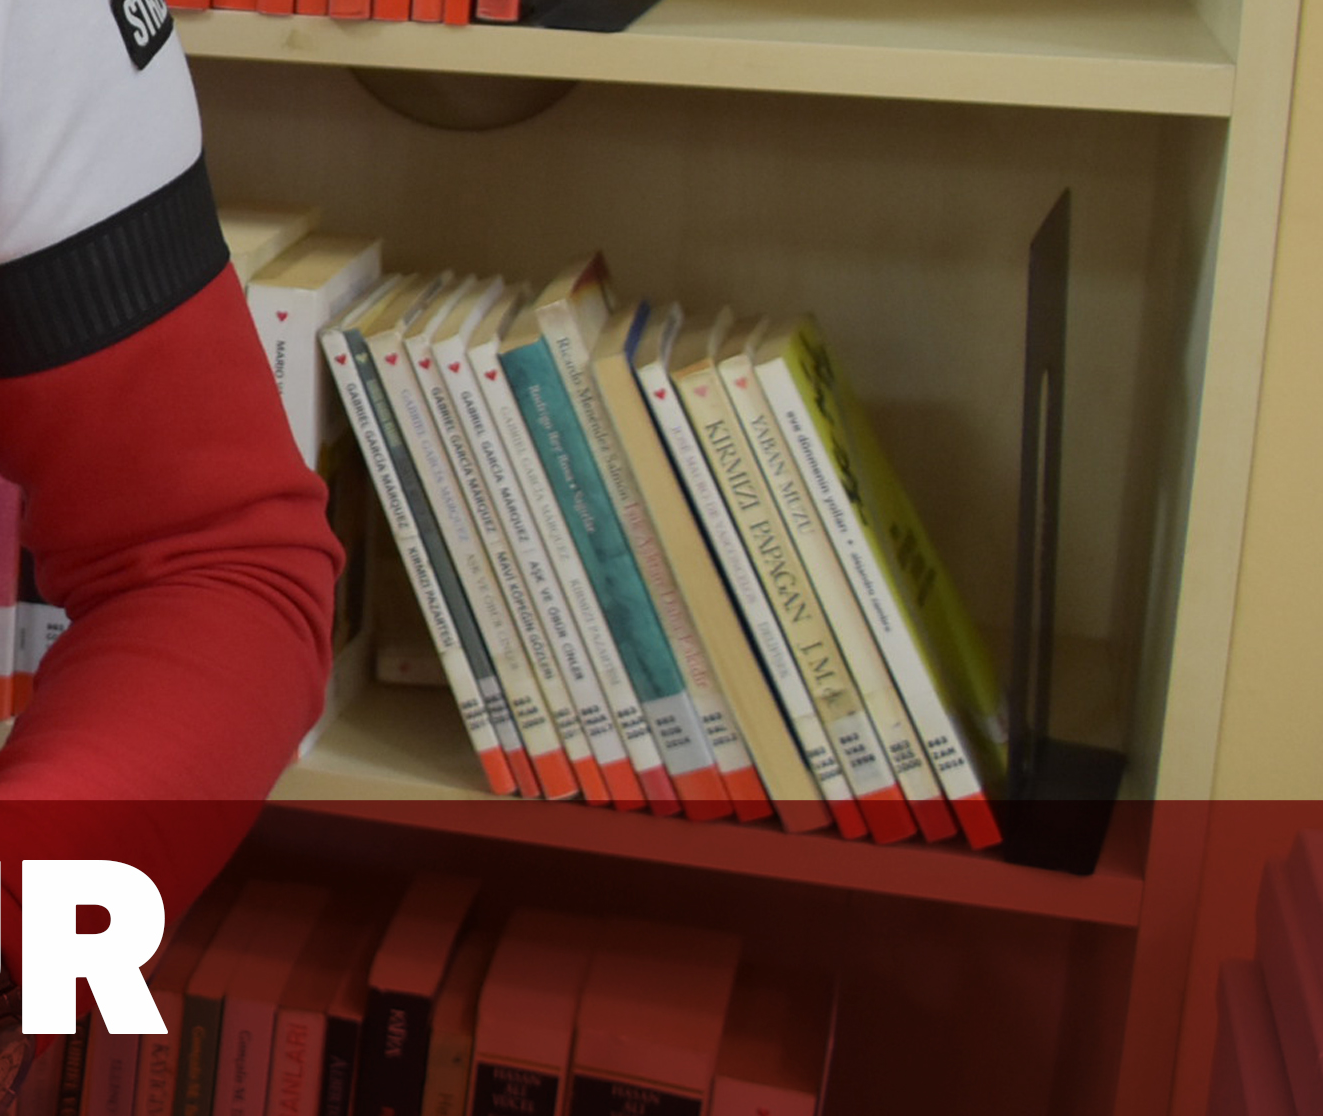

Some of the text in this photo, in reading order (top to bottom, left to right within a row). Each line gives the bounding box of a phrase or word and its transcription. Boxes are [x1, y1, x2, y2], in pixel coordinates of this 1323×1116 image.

[275, 340, 286, 379] MARIO
[556, 336, 583, 392] Ricardo
[346, 382, 454, 650] GABRIEL GARCÍA MÁRQUEZ KIRMIZI PAZARTESİ
[431, 386, 454, 434] GABRIEL
[449, 434, 475, 479] GARCÍA
[467, 478, 497, 534] MÁRQUEZ
[461, 390, 486, 438] GABRIEL
[480, 440, 506, 484] GARCÍA
[500, 487, 531, 544] MÁRQUEZ
[527, 560, 545, 587] AŞK
[540, 587, 554, 605] VE
[706, 420, 761, 511] KIRMIZI
[751, 413, 816, 535] YABAN MUZU
